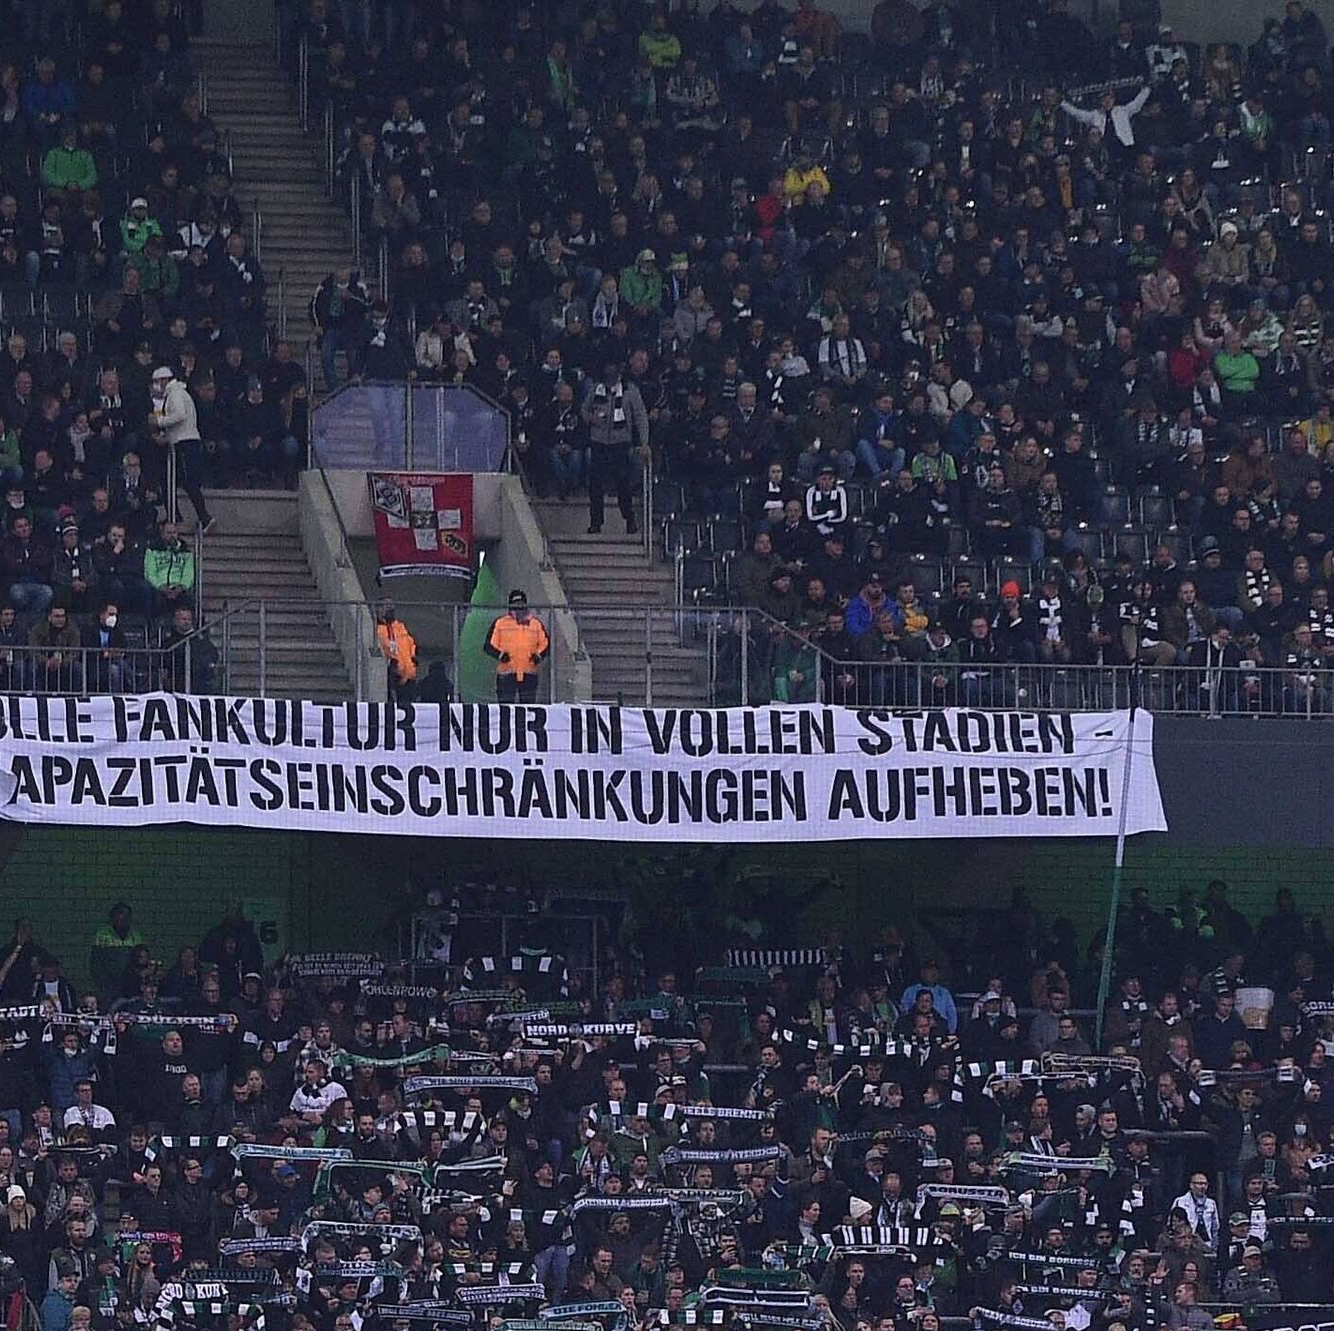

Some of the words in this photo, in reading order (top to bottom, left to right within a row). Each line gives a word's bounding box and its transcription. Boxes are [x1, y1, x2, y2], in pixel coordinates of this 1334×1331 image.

[114, 692, 418, 753] FANKULTUR
[441, 704, 548, 755] NUR
[571, 707, 623, 755] IN
[643, 706, 834, 757] VOLLEN
[857, 708, 1074, 756] STADIEN
[2, 747, 806, 825] APAZITÄTSEINSCHRÄNKUNGEN
[828, 766, 1113, 822] AUFHEBEN!
[526, 1024, 568, 1037] NORD
[583, 1023, 637, 1036] KURVE
[717, 1107, 766, 1121] BRENNT
[930, 1187, 1004, 1198] BORUSSIA
[1008, 1252, 1026, 1261] ICH
[1028, 1254, 1047, 1263] BIN
[1050, 1255, 1102, 1269] BORUSSE!
